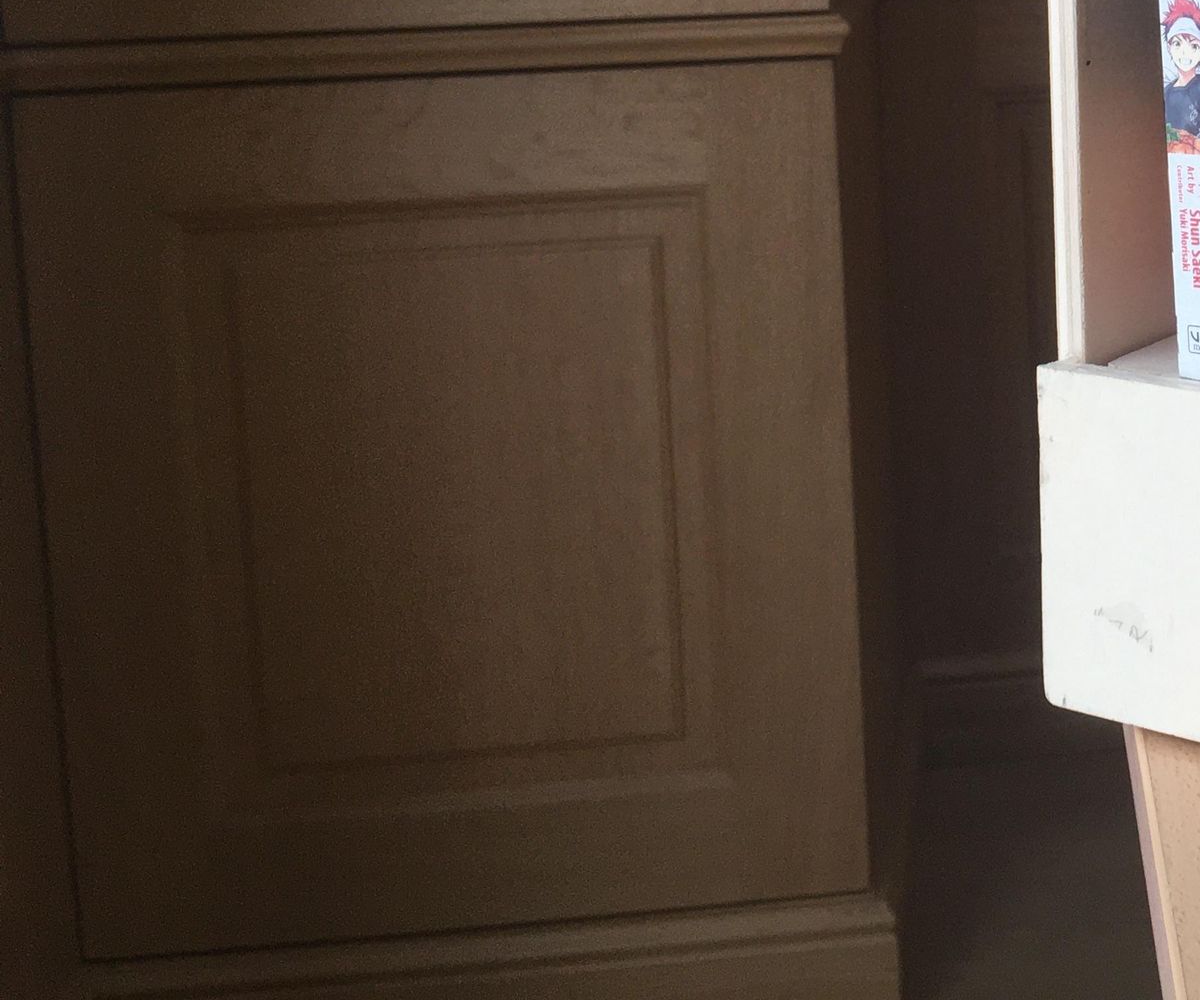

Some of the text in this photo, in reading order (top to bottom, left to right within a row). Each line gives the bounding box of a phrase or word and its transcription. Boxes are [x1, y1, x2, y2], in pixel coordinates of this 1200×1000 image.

[1186, 165, 1195, 181] Art
[1186, 183, 1196, 194] by
[1179, 208, 1189, 229] Yuki
[1180, 231, 1191, 272] Morisaki
